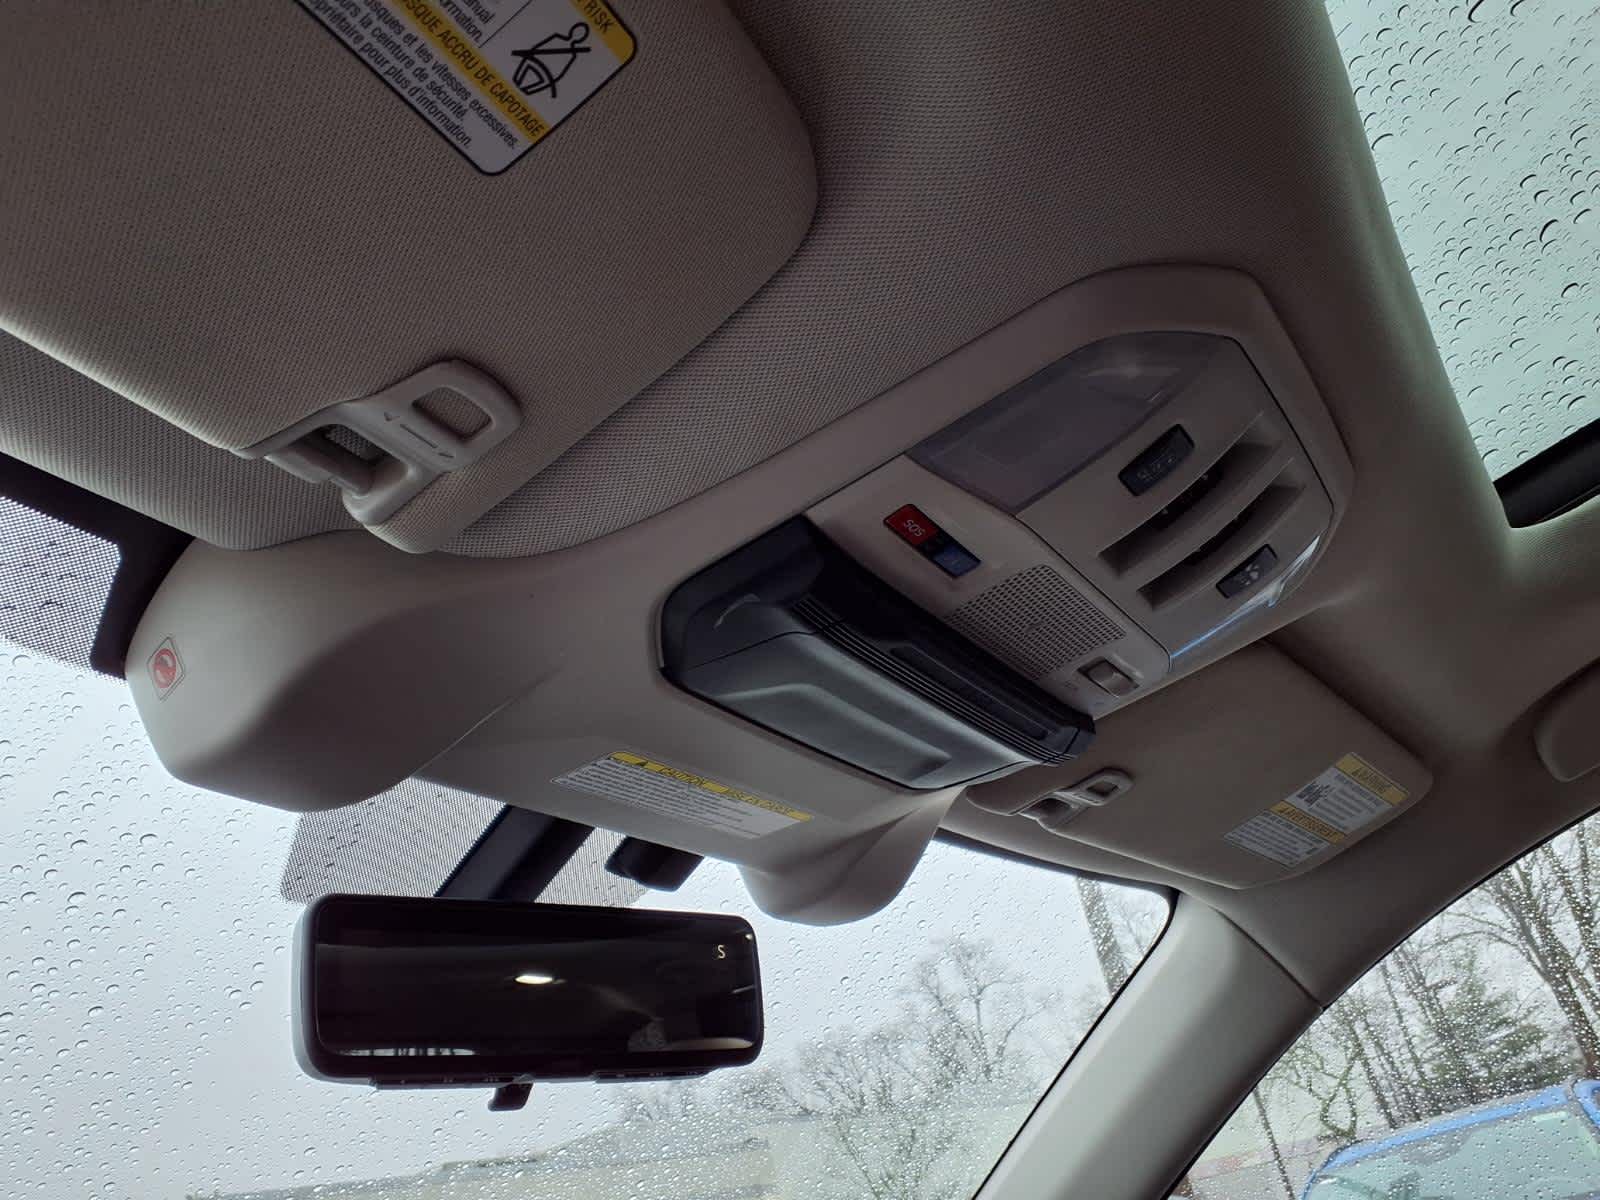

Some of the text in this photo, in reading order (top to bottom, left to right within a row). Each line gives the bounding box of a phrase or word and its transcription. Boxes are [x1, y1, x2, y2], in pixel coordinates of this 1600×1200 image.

[583, 0, 614, 34] RISK
[358, 42, 390, 68] pour
[384, 65, 411, 89] plus
[359, 12, 373, 29] la
[371, 26, 415, 69] ceinture
[412, 66, 429, 83] de
[402, 32, 419, 48] et
[415, 43, 433, 64] les
[431, 60, 472, 101] vitesses
[404, 0, 545, 137] SQUE ACCRU DE CAPOTAGE
[903, 519, 926, 537] SOS
[717, 944, 726, 959] S
